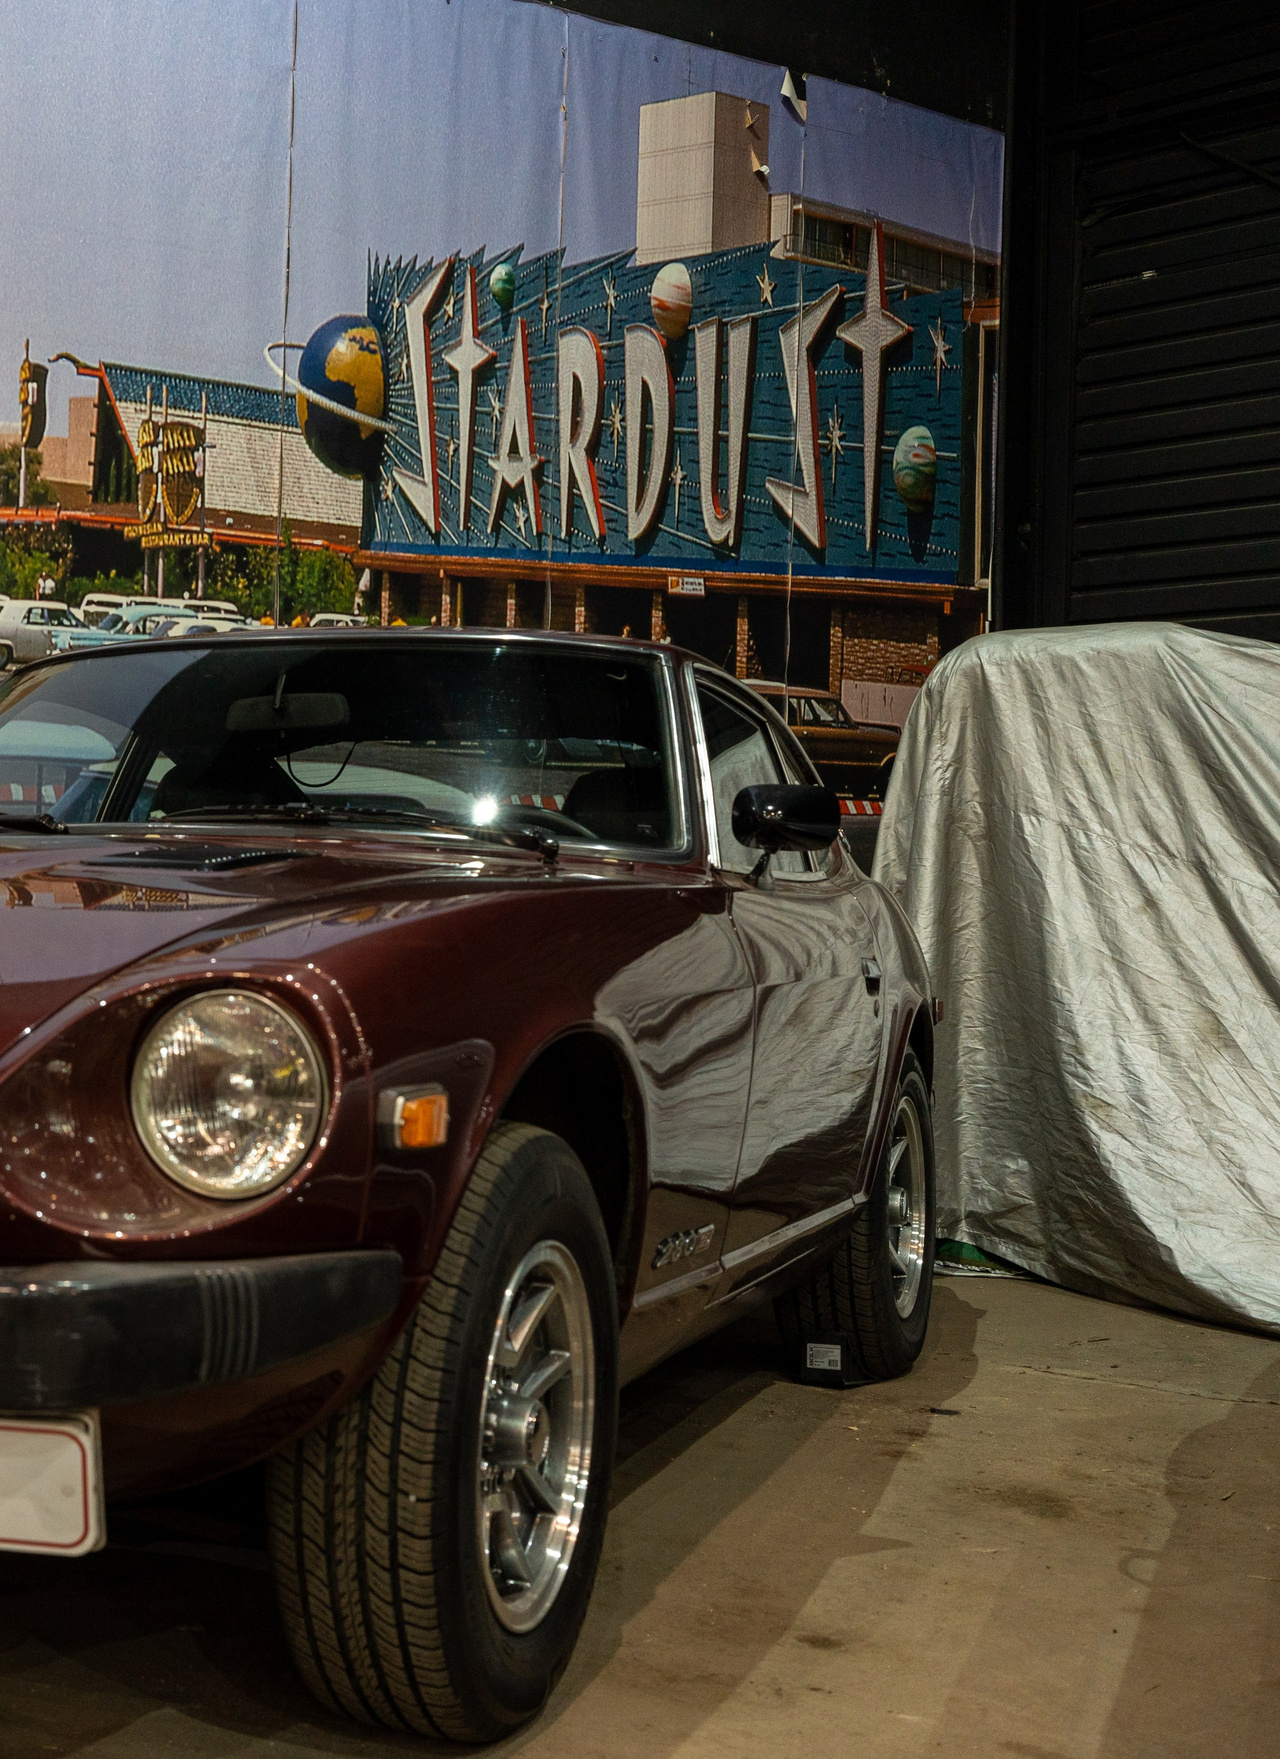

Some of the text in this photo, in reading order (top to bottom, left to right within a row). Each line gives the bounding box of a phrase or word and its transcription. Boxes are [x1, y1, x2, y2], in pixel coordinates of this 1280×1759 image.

[392, 220, 914, 553] STARDUST
[141, 533, 184, 549] RESTAURANT
[193, 533, 210, 546] BAR
